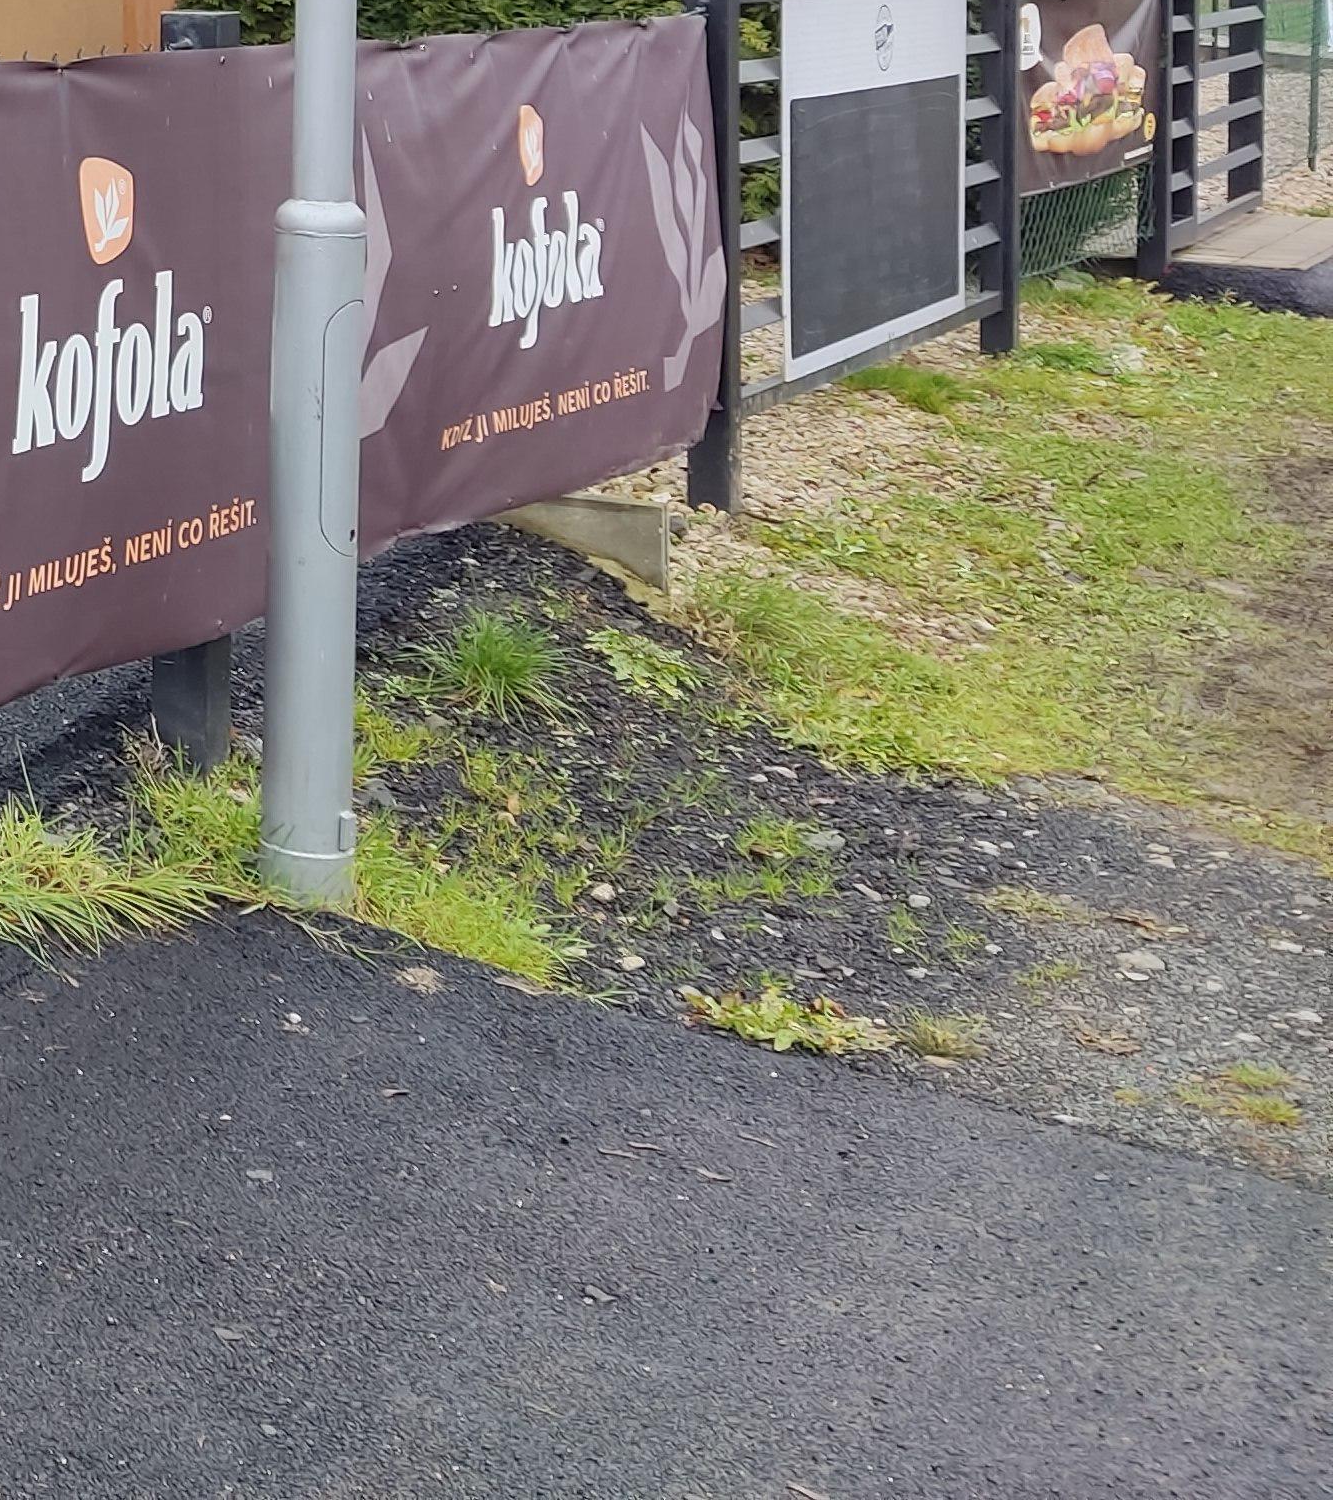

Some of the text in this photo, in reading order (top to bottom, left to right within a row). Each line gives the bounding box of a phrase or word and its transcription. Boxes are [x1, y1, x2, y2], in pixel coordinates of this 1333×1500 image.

[488, 190, 604, 349] kofola
[11, 270, 204, 482] kofola
[475, 414, 490, 443] JI
[493, 392, 554, 433] MILUJEŠ,
[558, 380, 590, 415] NENÍ
[594, 381, 611, 405] CO
[614, 367, 650, 399] ŘEŠIT.
[3, 572, 21, 611] JI
[28, 535, 117, 597] MILUJEŠ,
[125, 519, 173, 566] NENÍ
[178, 518, 203, 548] CO
[209, 497, 257, 540] ŘEŠIT.
